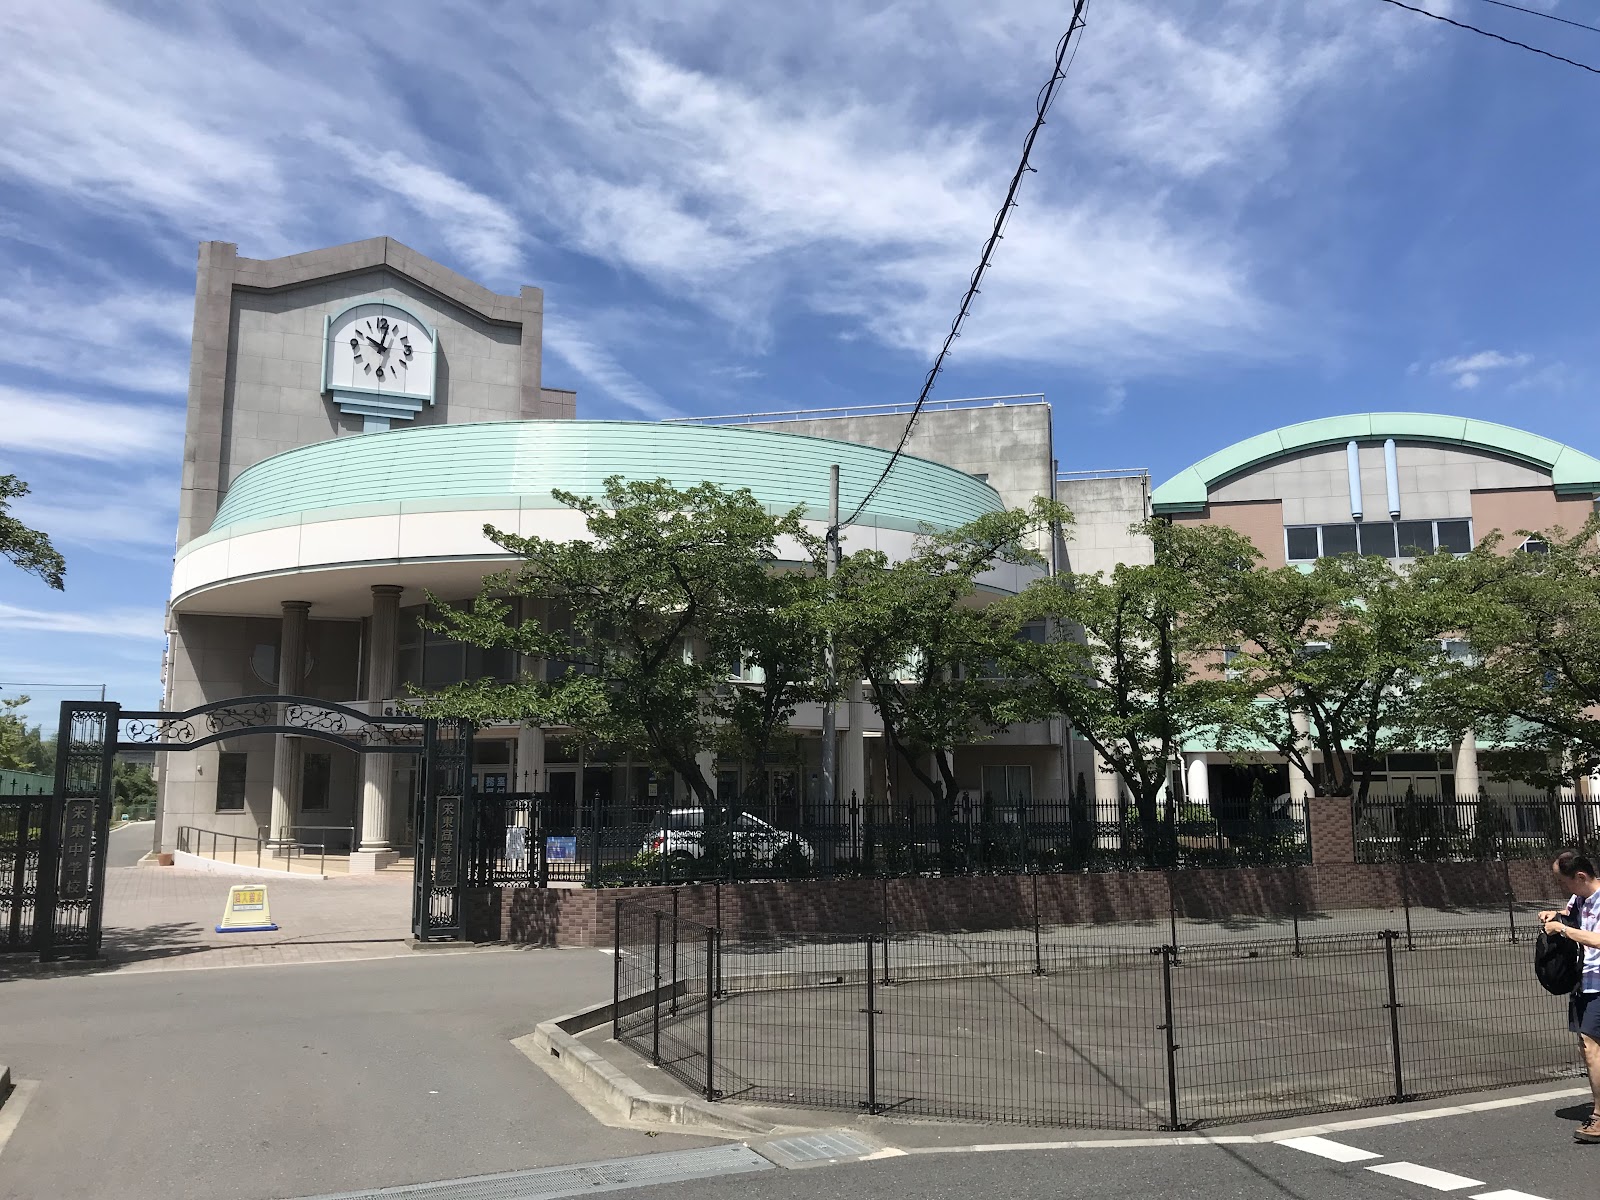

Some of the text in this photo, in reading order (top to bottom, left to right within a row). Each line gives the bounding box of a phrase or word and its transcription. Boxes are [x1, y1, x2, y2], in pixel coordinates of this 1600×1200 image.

[376, 317, 388, 330] 12
[350, 338, 359, 349] 9
[403, 344, 412, 356] 3
[375, 365, 384, 378] 6
[438, 802, 455, 883] 栄東高等学校
[66, 805, 88, 894] 栄東中学校
